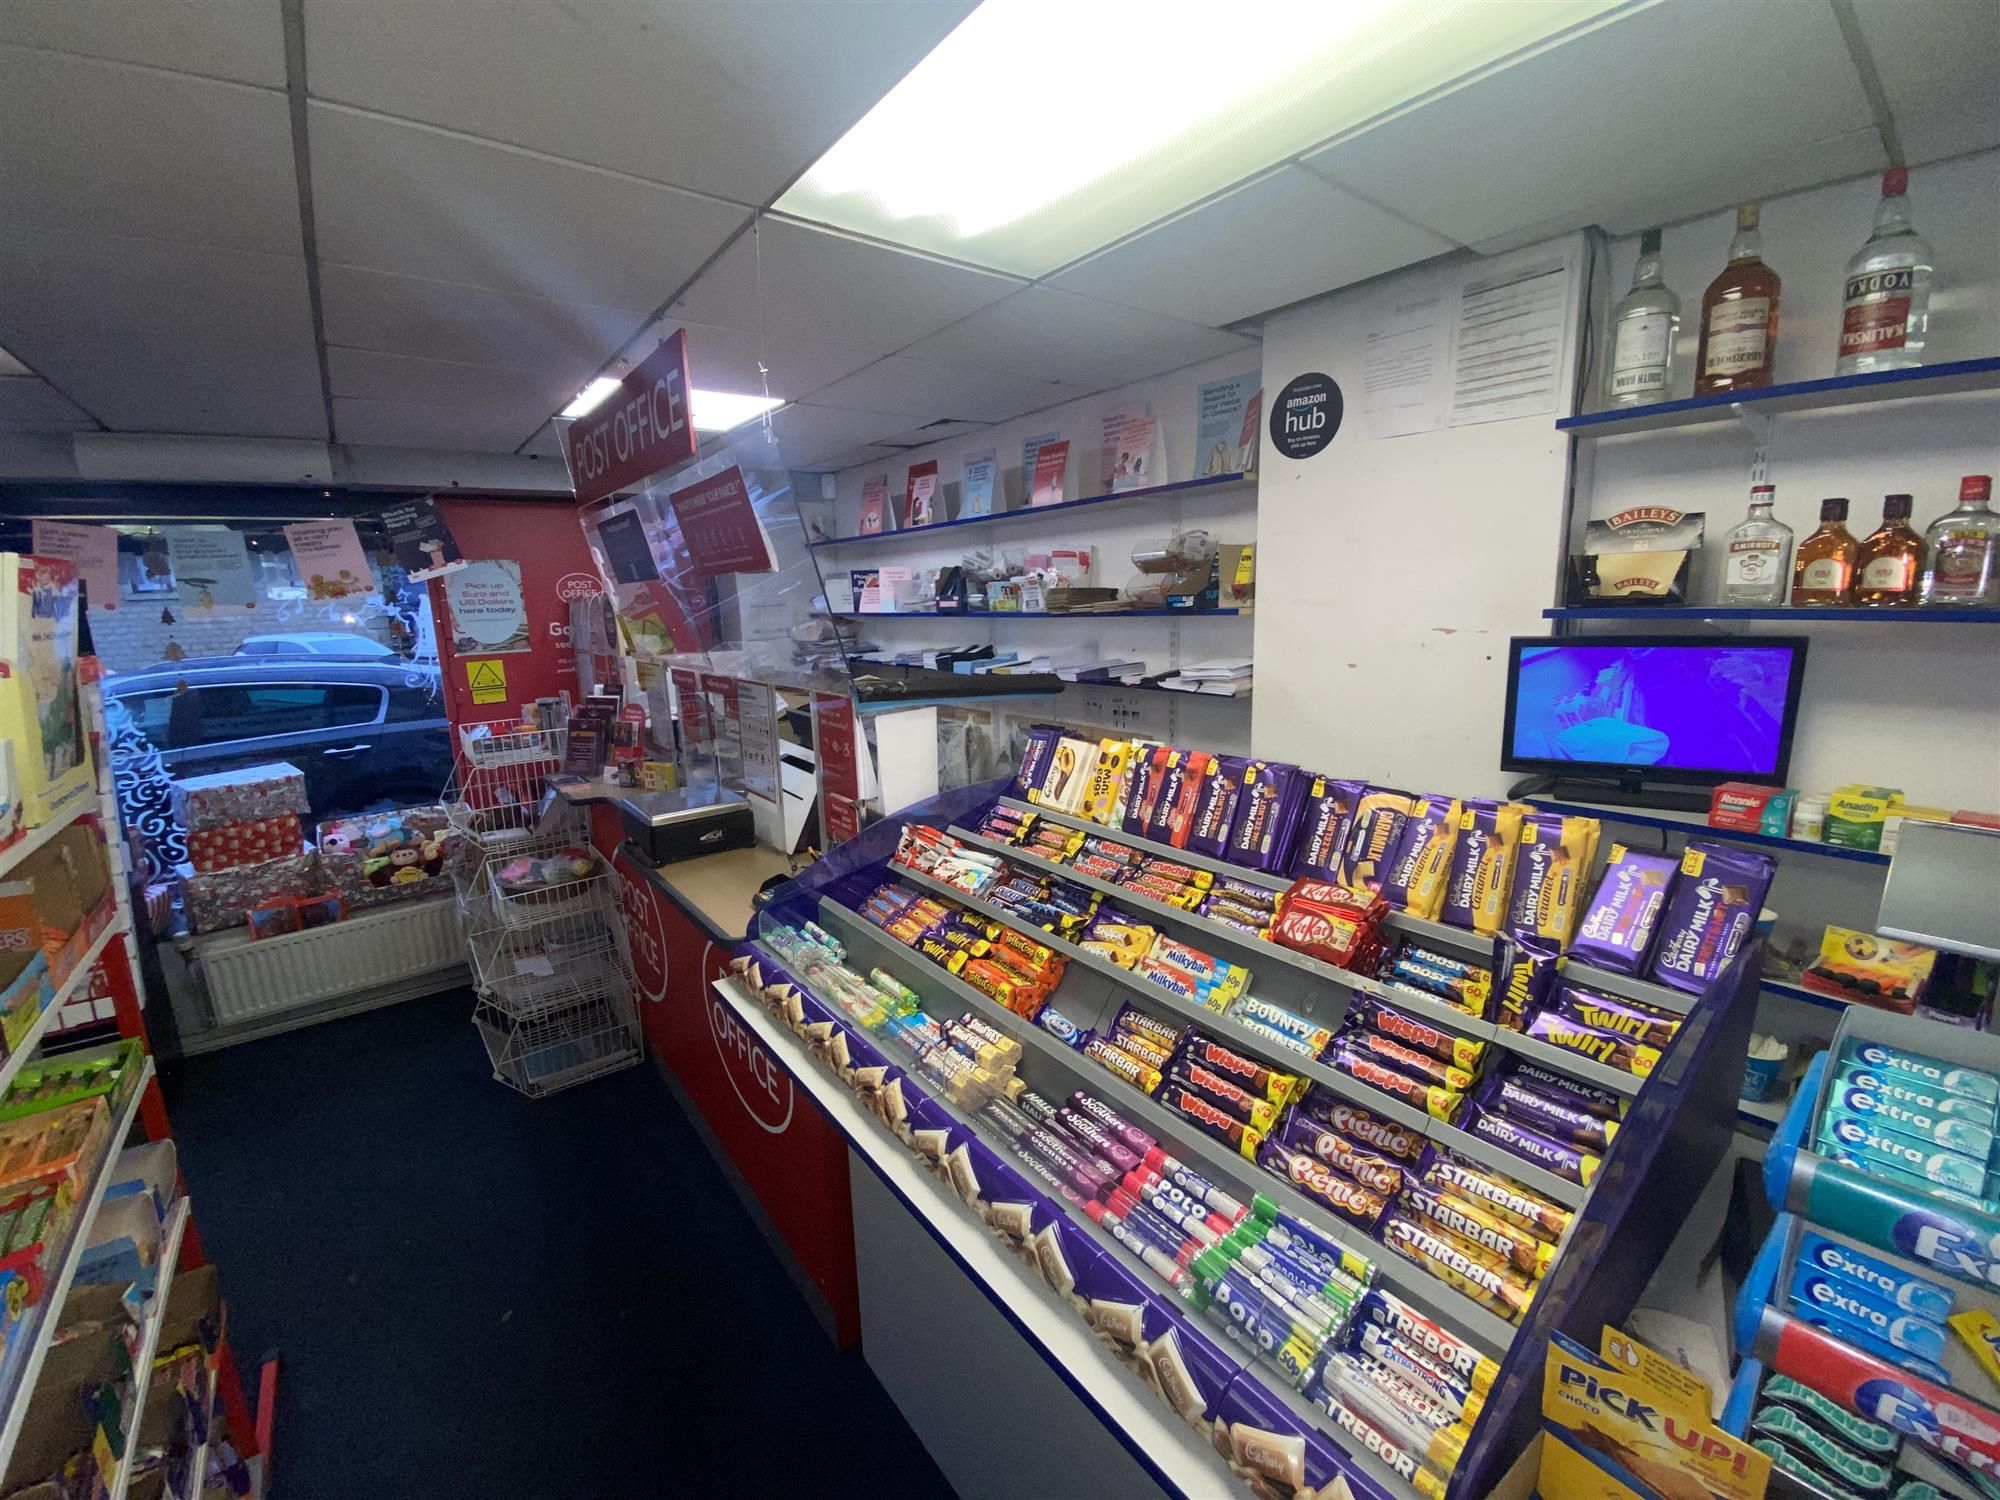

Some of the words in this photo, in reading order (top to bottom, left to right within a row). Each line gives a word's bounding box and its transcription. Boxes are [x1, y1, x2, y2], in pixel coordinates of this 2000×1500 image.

[1848, 270, 1910, 299] VODKA
[1286, 391, 1327, 409] amazon
[575, 419, 611, 484] POST
[613, 367, 685, 463] OFFICE
[1284, 406, 1326, 434] hub
[1611, 506, 1680, 528] BAILEYS
[1729, 541, 1779, 553] SMIRNOFF
[461, 590, 489, 598] Euro
[562, 589, 600, 599] OFFICE
[567, 580, 593, 588] POST
[1616, 577, 1659, 590] BAILEYS
[458, 607, 485, 615] here
[486, 605, 517, 615] today
[478, 598, 515, 606] Dollars
[1092, 766, 1104, 798] eggs
[1103, 767, 1114, 797] Mini
[1158, 801, 1171, 827] DAIRY
[1166, 779, 1178, 804] MILK
[1199, 809, 1213, 838] DAIRY
[1206, 782, 1221, 811] MILK
[1247, 789, 1261, 821] MILK
[1720, 793, 1760, 808] Rennie
[1836, 799, 1880, 813] Anadin
[1100, 840, 1132, 857] Wispa
[1240, 820, 1255, 850] DAIRY
[1307, 835, 1322, 865] DAIRY
[1315, 811, 1330, 838] MILK
[1367, 811, 1394, 861] CARAMILK
[1072, 863, 1102, 878] Wispa
[1088, 855, 1120, 872] Wispa
[1151, 859, 1194, 879] crunchie
[1397, 857, 1417, 888] DAIRY
[1410, 833, 1427, 859] MILK
[1466, 844, 1481, 871] MILK
[1530, 858, 1545, 888] MILK
[1011, 877, 1041, 898] SNICKERS
[1122, 880, 1163, 901] crunchie
[1301, 883, 1351, 901] KitKat
[1459, 869, 1475, 908] DAIRY
[1472, 860, 1489, 911] Caramel
[1537, 876, 1555, 927] Caramel
[1207, 912, 1229, 926] DAIRY
[1229, 920, 1247, 933] MILK
[1218, 899, 1240, 912] DAIRY
[1239, 905, 1258, 917] MILK
[1523, 886, 1539, 926] DAIRY
[1582, 905, 1611, 939] Cadbury
[1595, 909, 1618, 941] DAIRY
[1611, 881, 1633, 911] MILK
[1282, 911, 1332, 942] KitKat
[1675, 931, 1700, 973] DAIRY
[1690, 898, 1714, 932] MILK
[1415, 948, 1465, 972] BOOST
[1660, 929, 1688, 968] Cadbury
[1165, 949, 1209, 975] Milkybar
[1226, 973, 1241, 989] 60p
[1399, 960, 1450, 982] BOOST
[1146, 970, 1191, 997] Milkybar
[1206, 995, 1222, 1011] 60p
[1465, 984, 1483, 998] 60
[1127, 1010, 1178, 1041] STARBAR
[1247, 997, 1316, 1038] BOUNTY
[713, 1001, 781, 1105] OFFICE
[1115, 1033, 1165, 1068] STARBAR
[1377, 1011, 1439, 1048] Wispa
[1458, 1046, 1476, 1062] 60
[1091, 1040, 1142, 1079] STARBAR
[1205, 1043, 1257, 1078] Wispa
[1271, 1079, 1288, 1093] 60
[1350, 1058, 1414, 1095] Wispa
[1369, 1034, 1432, 1070] Wispa
[1449, 1072, 1469, 1088] 60
[1633, 1056, 1653, 1071] 60
[1862, 1047, 1942, 1080] extra
[1190, 1066, 1242, 1100] Wispa
[1516, 1063, 1557, 1086] DAIRY
[1556, 1075, 1594, 1099] MILK
[1854, 1075, 1936, 1109] extra
[1025, 1091, 1056, 1117] HALLS
[1081, 1096, 1126, 1132] Soothers
[1180, 1092, 1233, 1130] Wispa
[1501, 1086, 1541, 1110] DAIRY
[1541, 1099, 1579, 1125] MILK
[1850, 1092, 1933, 1130] extra
[1034, 1130, 1078, 1167] Soothers
[1066, 1112, 1110, 1149] Soothers
[1330, 1105, 1412, 1157] Picnic
[1476, 1117, 1519, 1143] DAIRY
[1517, 1134, 1555, 1162] MILK
[1839, 1123, 1924, 1164] extra
[1314, 1133, 1393, 1196] Picnic
[1157, 1180, 1207, 1220] POLO
[1289, 1153, 1373, 1215] Picnic
[1437, 1163, 1543, 1222] STARBAR
[1411, 1192, 1515, 1258] STARBAR
[1393, 1219, 1502, 1293] STARBAR
[1820, 1247, 1896, 1293] extra
[1812, 1280, 1889, 1328] extra
[1214, 1283, 1276, 1350] POLO
[1277, 1349, 1301, 1377] 50p
[1384, 1304, 1474, 1378] TREBOR
[1358, 1353, 1456, 1428] TREBOR
[1384, 1349, 1413, 1371] EXTRA
[1410, 1365, 1448, 1400] STRONG
[1556, 1388, 1601, 1416] CHOCO
[1324, 1396, 1416, 1481] TREBOR
[1662, 1415, 1749, 1480] UP!
[1244, 1440, 1286, 1474] Cadbury
